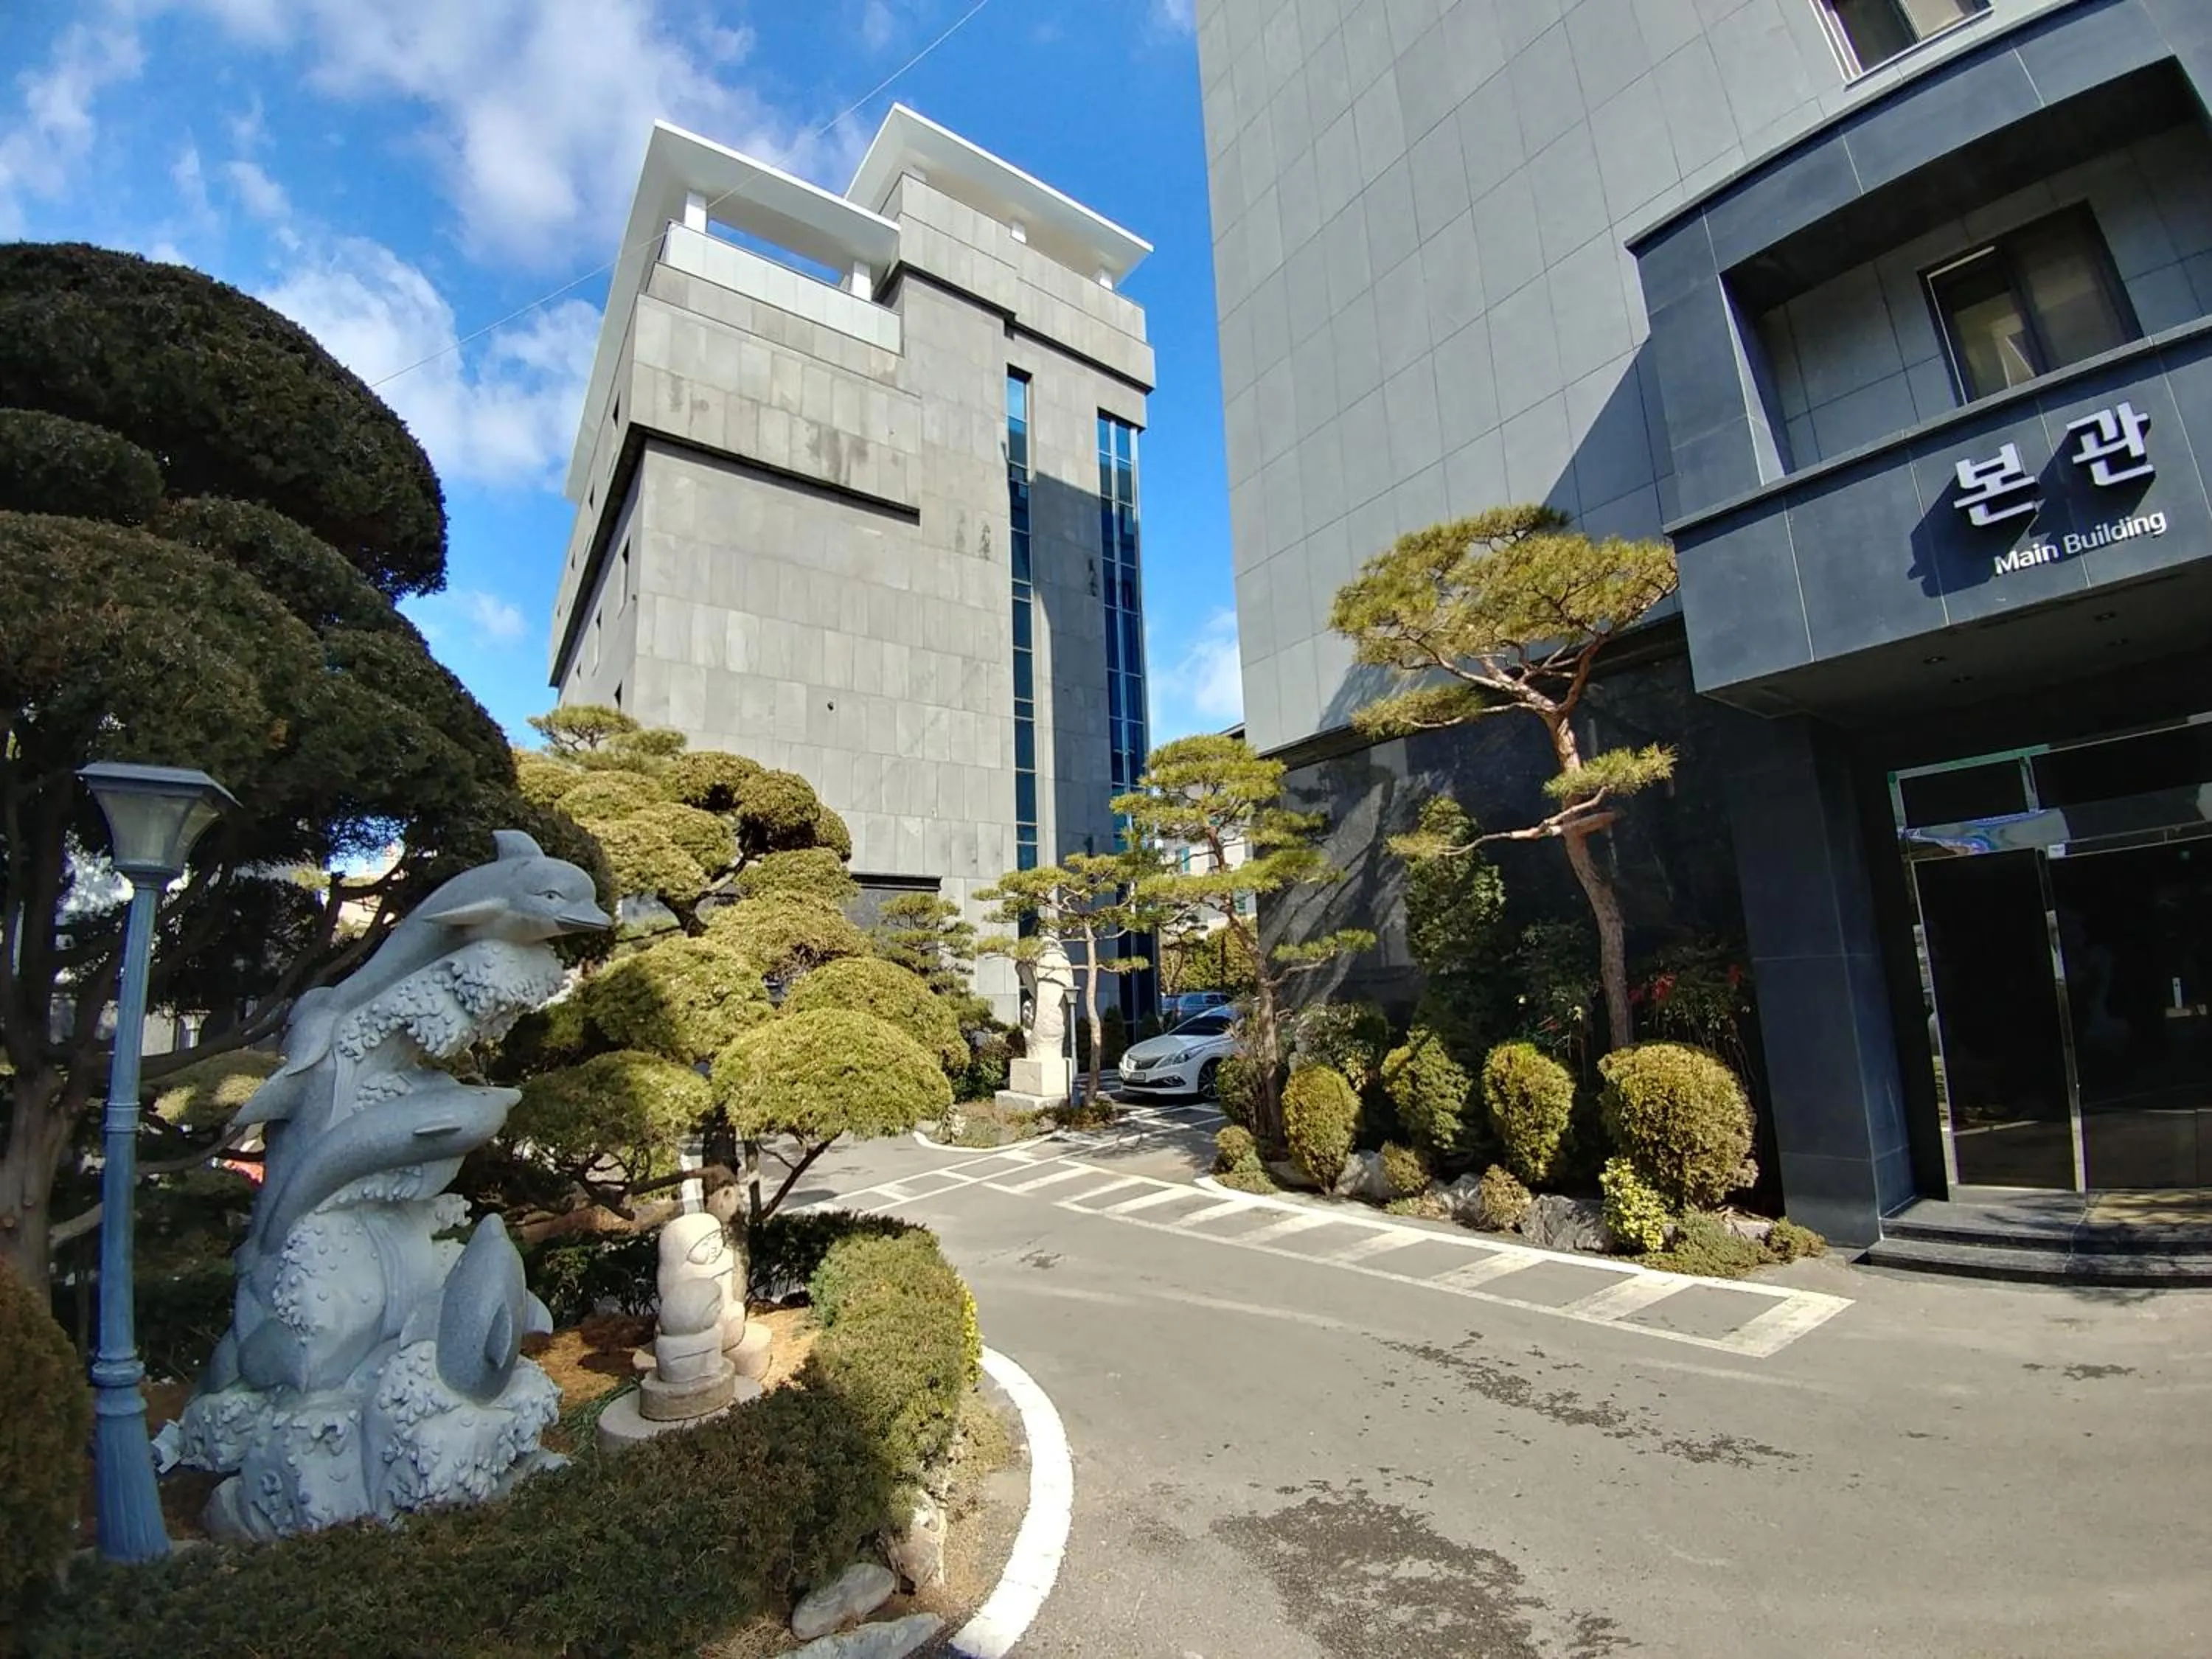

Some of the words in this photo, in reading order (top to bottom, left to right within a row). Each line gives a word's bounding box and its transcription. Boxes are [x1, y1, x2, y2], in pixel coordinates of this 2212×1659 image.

[1953, 401, 2157, 527] 본관
[1993, 543, 2059, 574] Main
[2062, 511, 2168, 554] Building
